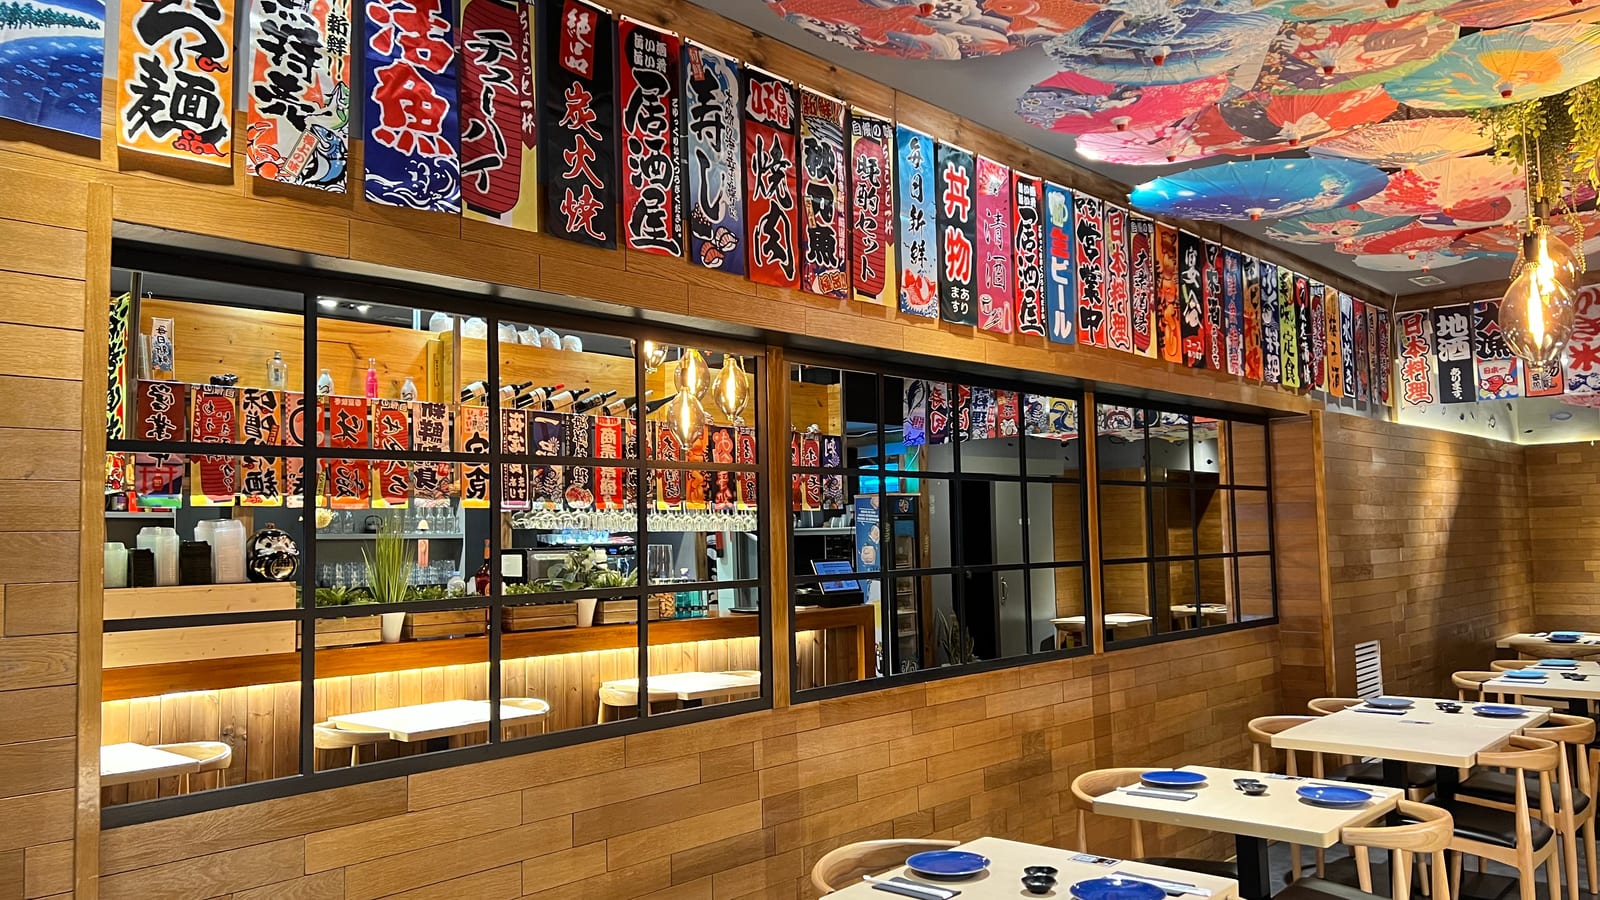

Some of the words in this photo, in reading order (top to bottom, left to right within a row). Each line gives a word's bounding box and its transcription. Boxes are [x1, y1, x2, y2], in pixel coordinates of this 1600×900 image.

[366, 0, 457, 157] 活魚
[565, 8, 592, 74] 絶品
[461, 29, 519, 193] チューハイ
[559, 81, 606, 240] 炭火焼
[623, 67, 681, 257] 居酒屋
[752, 133, 794, 280] 焼肉
[803, 138, 838, 267] 秋刀魚
[855, 155, 881, 281] 晩酌セット
[906, 137, 928, 268] 毎日新鮮
[943, 161, 973, 284] 丼物
[984, 208, 1008, 293] 清酒
[950, 286, 970, 315] あります
[1015, 205, 1045, 336] 居酒屋
[1049, 227, 1072, 338] 生ビール
[1076, 218, 1103, 344] 営業中
[1109, 211, 1129, 347] 日本料理
[1181, 247, 1203, 330] 宴会
[1402, 313, 1430, 402] 日本料理
[1436, 313, 1471, 361] 地酒
[1483, 366, 1506, 375] 日本一
